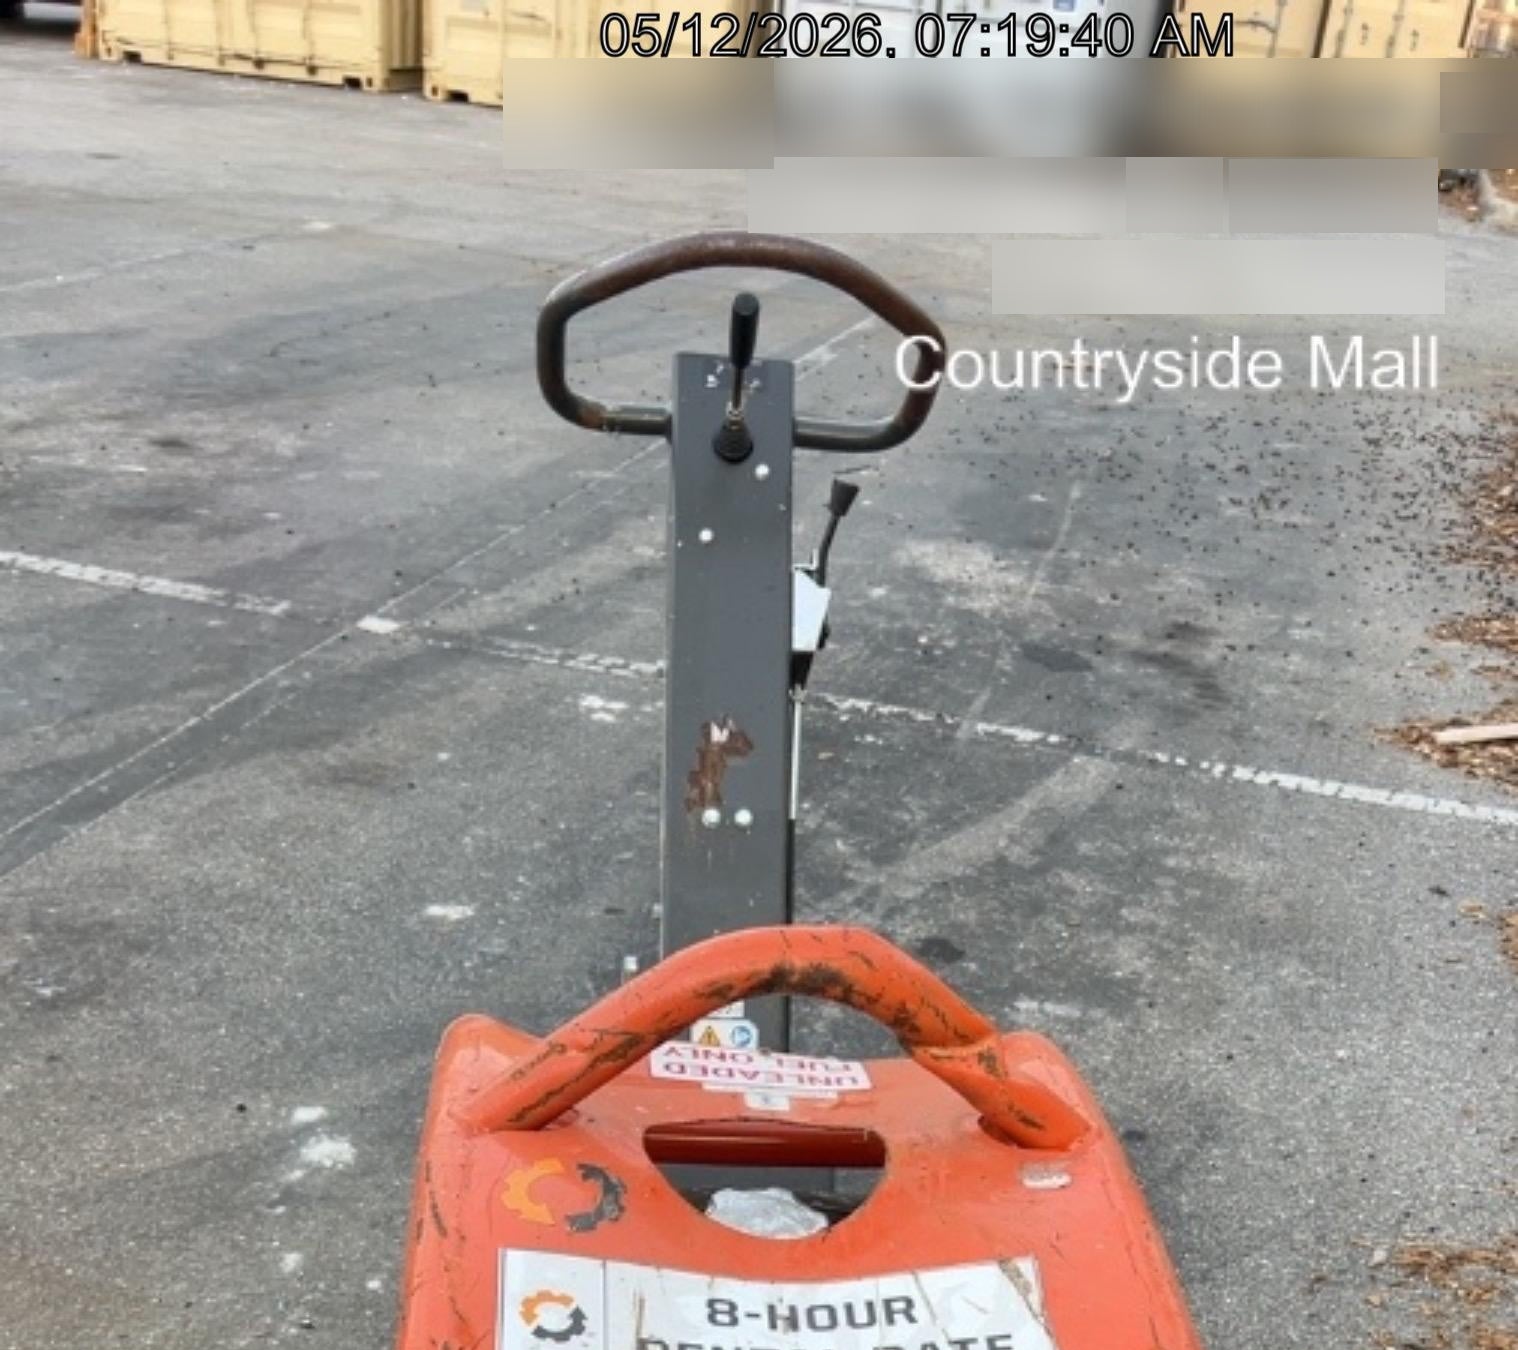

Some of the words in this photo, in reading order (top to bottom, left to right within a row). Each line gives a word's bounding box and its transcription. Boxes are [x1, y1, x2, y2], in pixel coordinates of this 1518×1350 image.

[662, 1046, 755, 1063] ONLY
[775, 1056, 853, 1072] FUEL
[662, 1063, 859, 1086] UNLEADED
[706, 1296, 919, 1332] 8-HOUR
